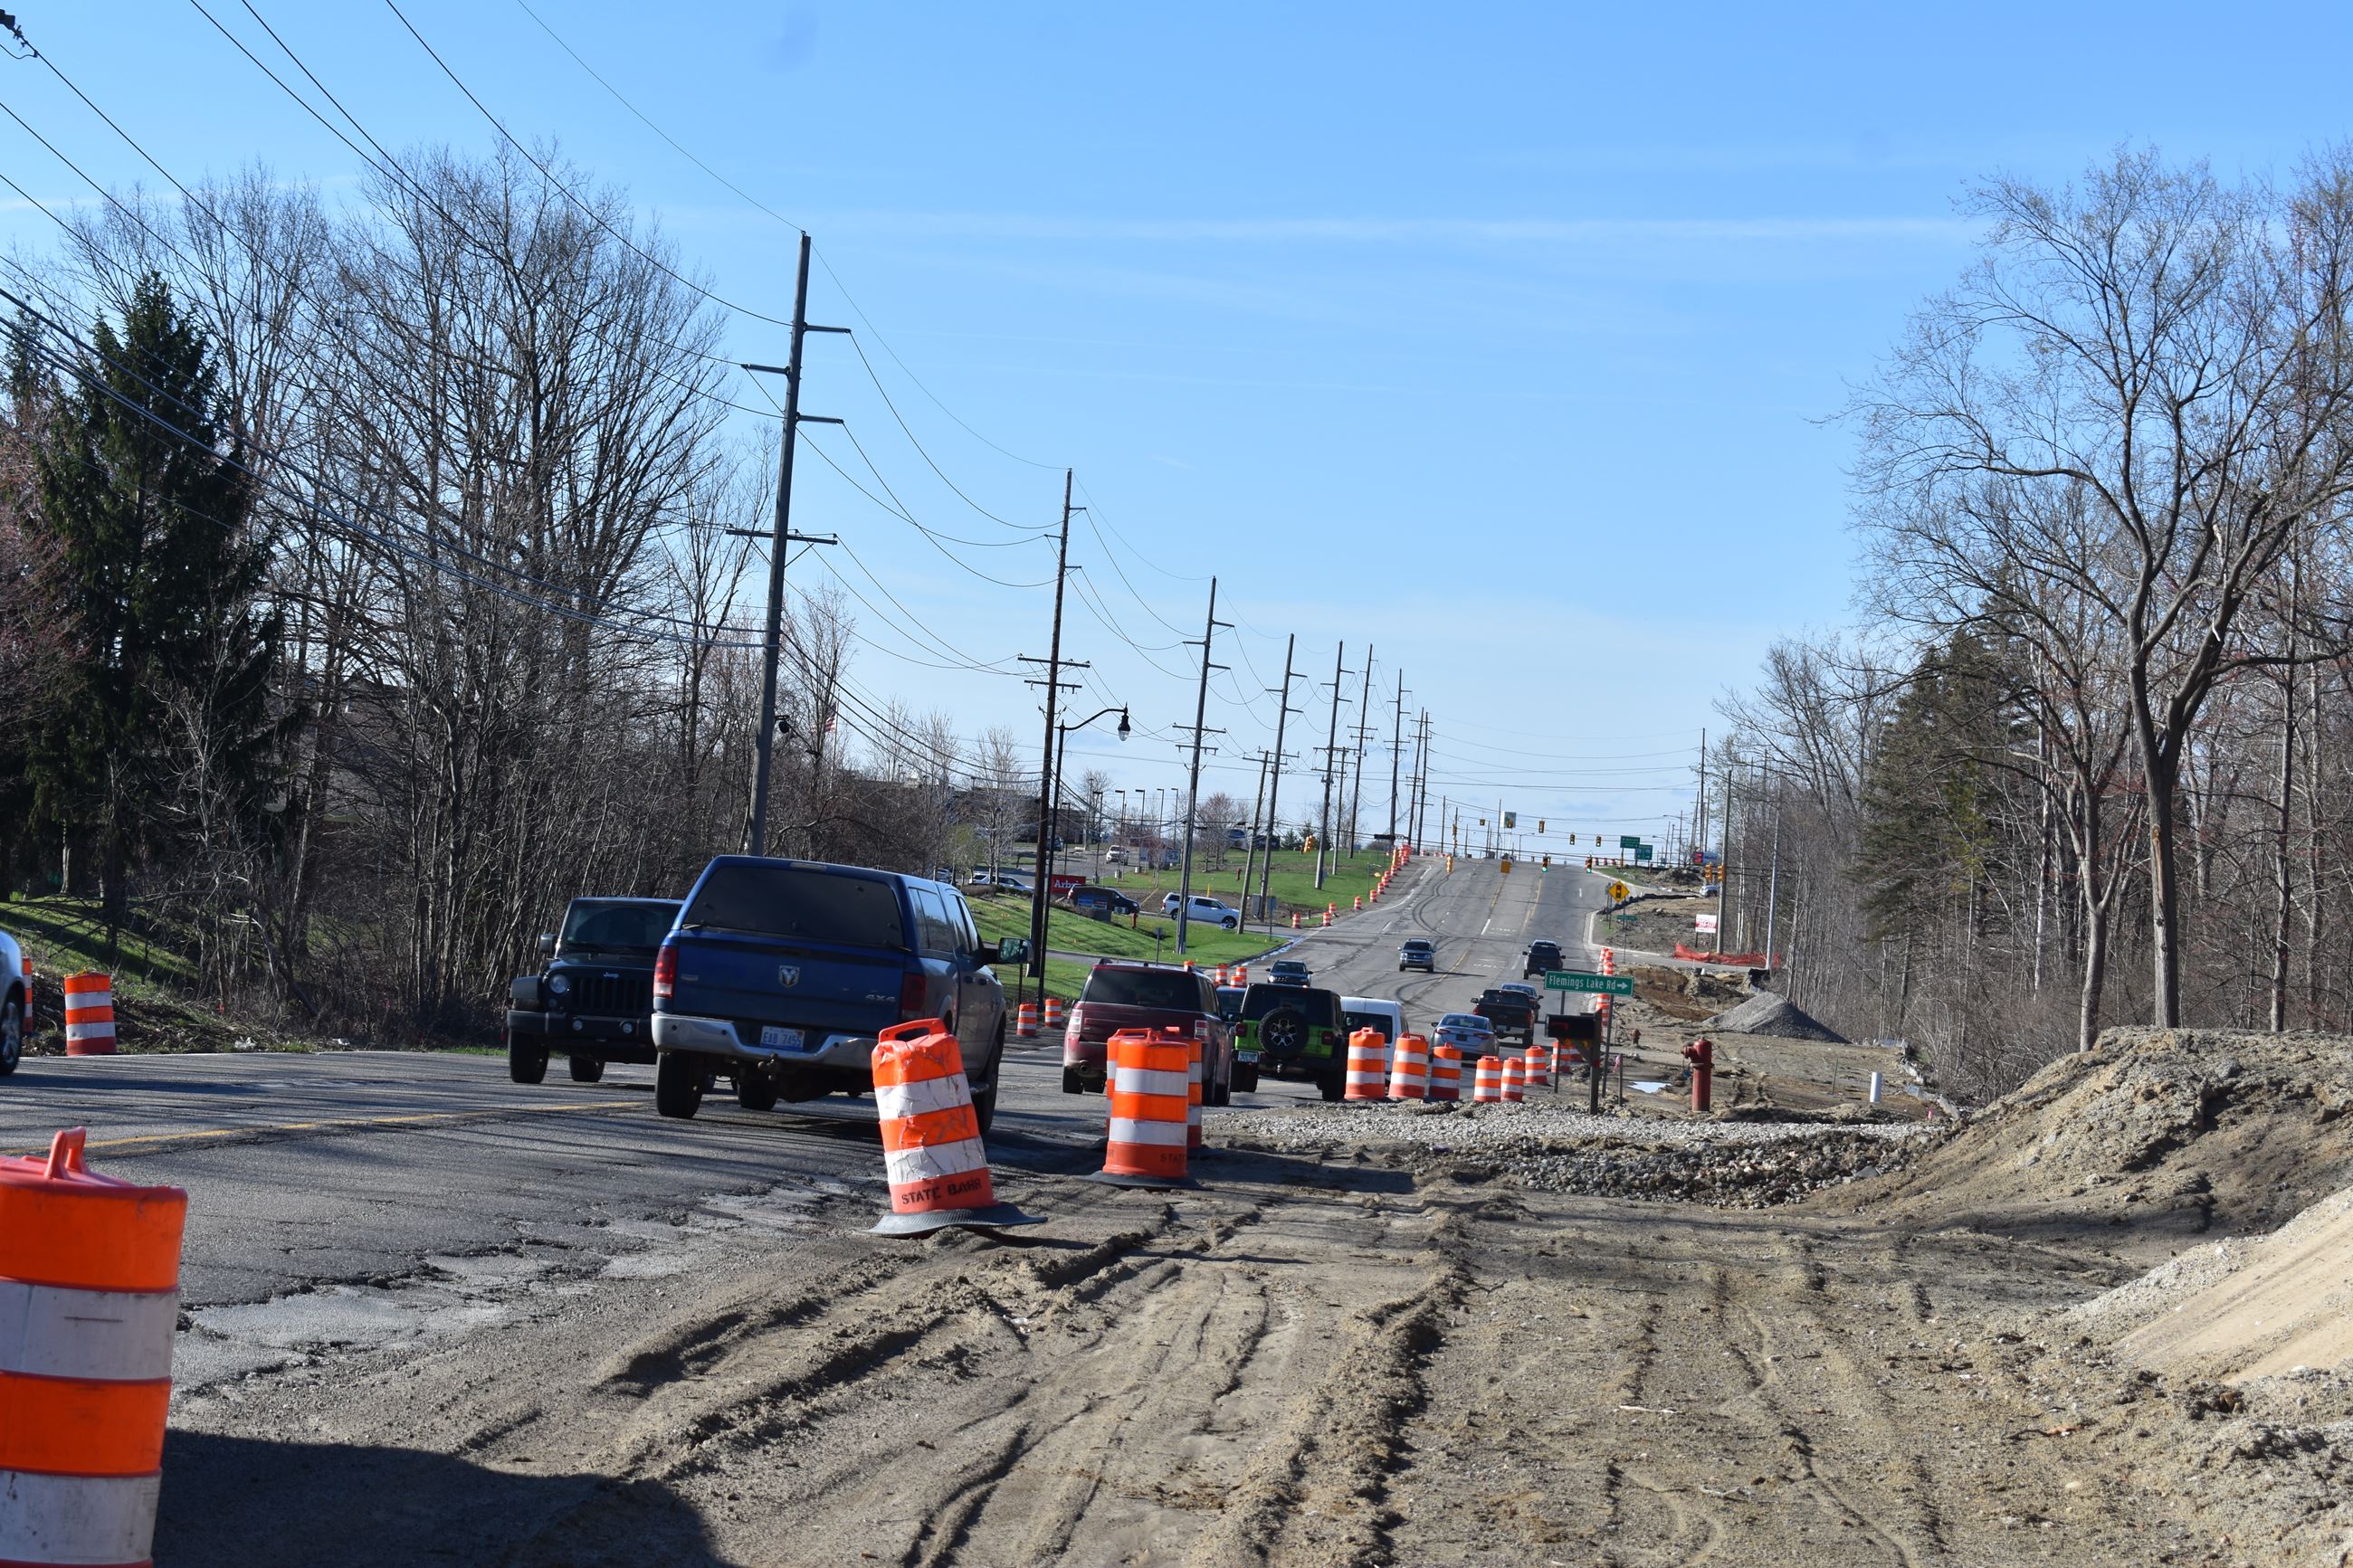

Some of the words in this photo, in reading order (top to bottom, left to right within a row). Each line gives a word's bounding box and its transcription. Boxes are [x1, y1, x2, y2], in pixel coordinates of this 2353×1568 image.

[603, 971, 620, 979] Jeep
[1548, 974, 1584, 990] Flemings
[1586, 978, 1605, 990] Lake
[1606, 980, 1616, 991] Rd
[900, 1186, 942, 1204] STATE
